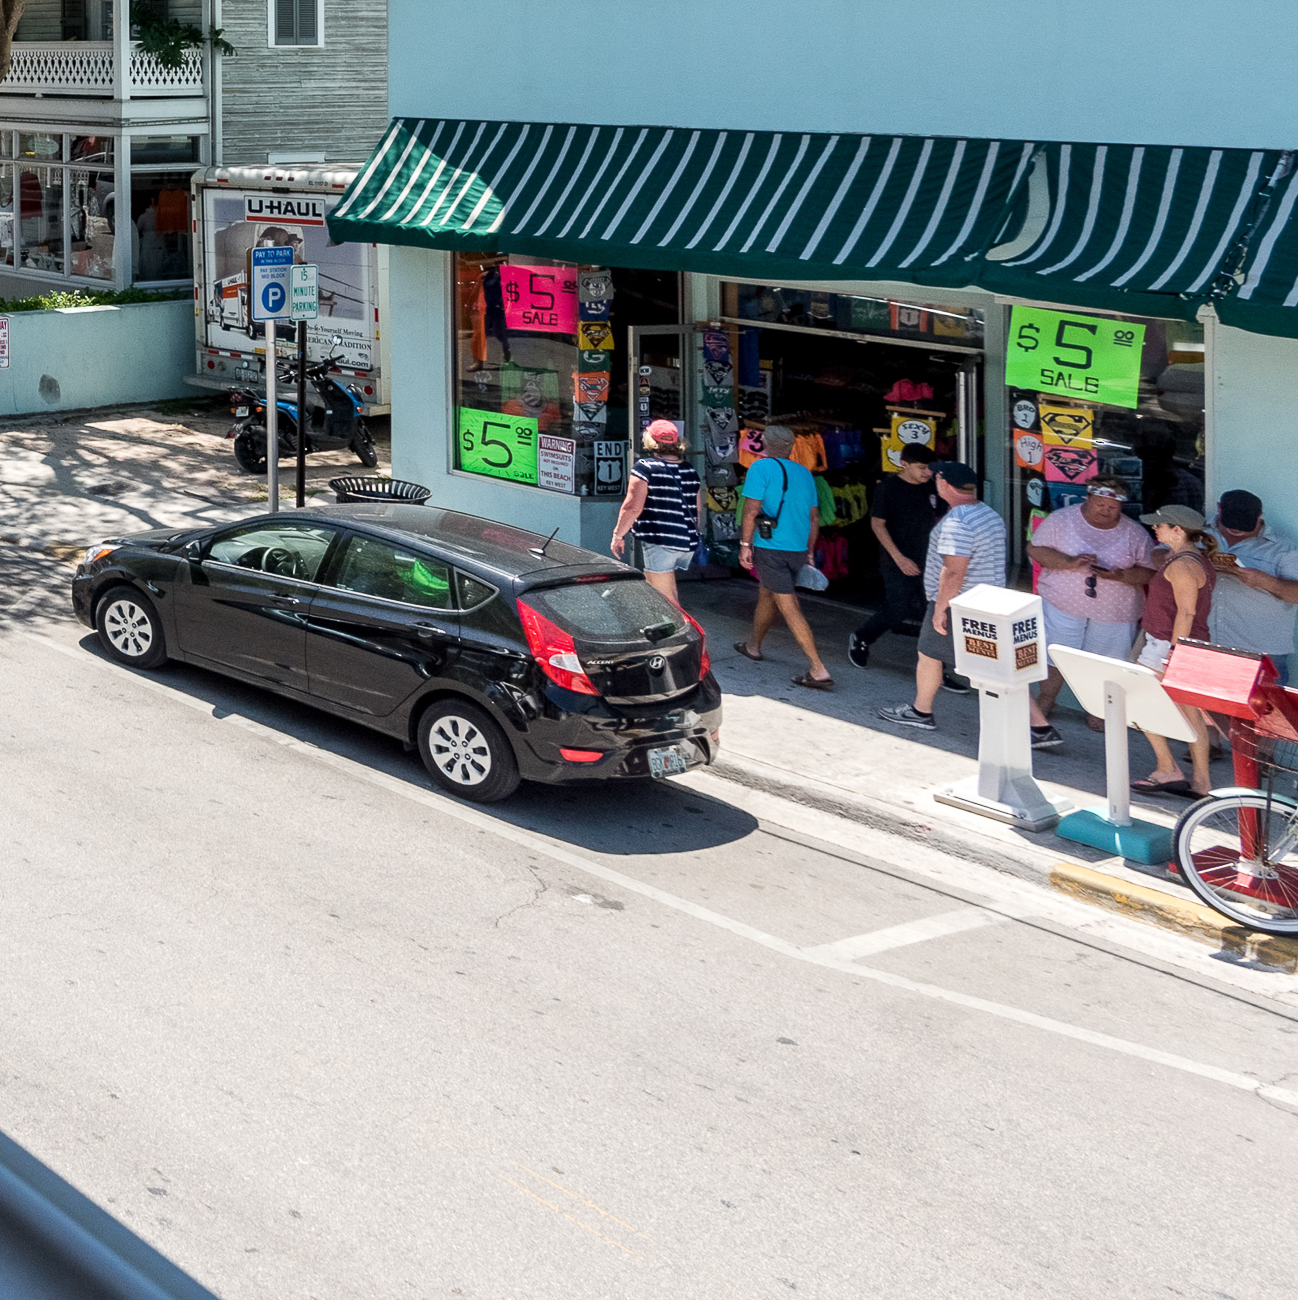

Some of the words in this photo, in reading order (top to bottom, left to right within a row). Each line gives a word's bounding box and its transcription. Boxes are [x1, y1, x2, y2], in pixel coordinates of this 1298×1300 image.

[247, 199, 323, 217] U-HAUL
[300, 271, 308, 281] 15
[268, 287, 281, 308] P
[293, 285, 315, 297] MINUTE
[292, 301, 316, 313] PARKING
[522, 311, 558, 326] SALE
[1040, 368, 1099, 394] SALE
[911, 431, 919, 439] 3
[541, 436, 572, 452] WARNING
[597, 442, 622, 456] END
[1020, 437, 1043, 452] High
[540, 451, 571, 461] SWIMSUITS
[1027, 452, 1033, 464] 1
[541, 470, 552, 478] THIS
[553, 473, 571, 481] BEACH
[607, 463, 612, 480] 1
[961, 617, 997, 634] FREE
[1012, 617, 1037, 636] FREE
[962, 628, 998, 640] MENUS
[1013, 630, 1038, 644] MENUS
[968, 638, 995, 651] BEST
